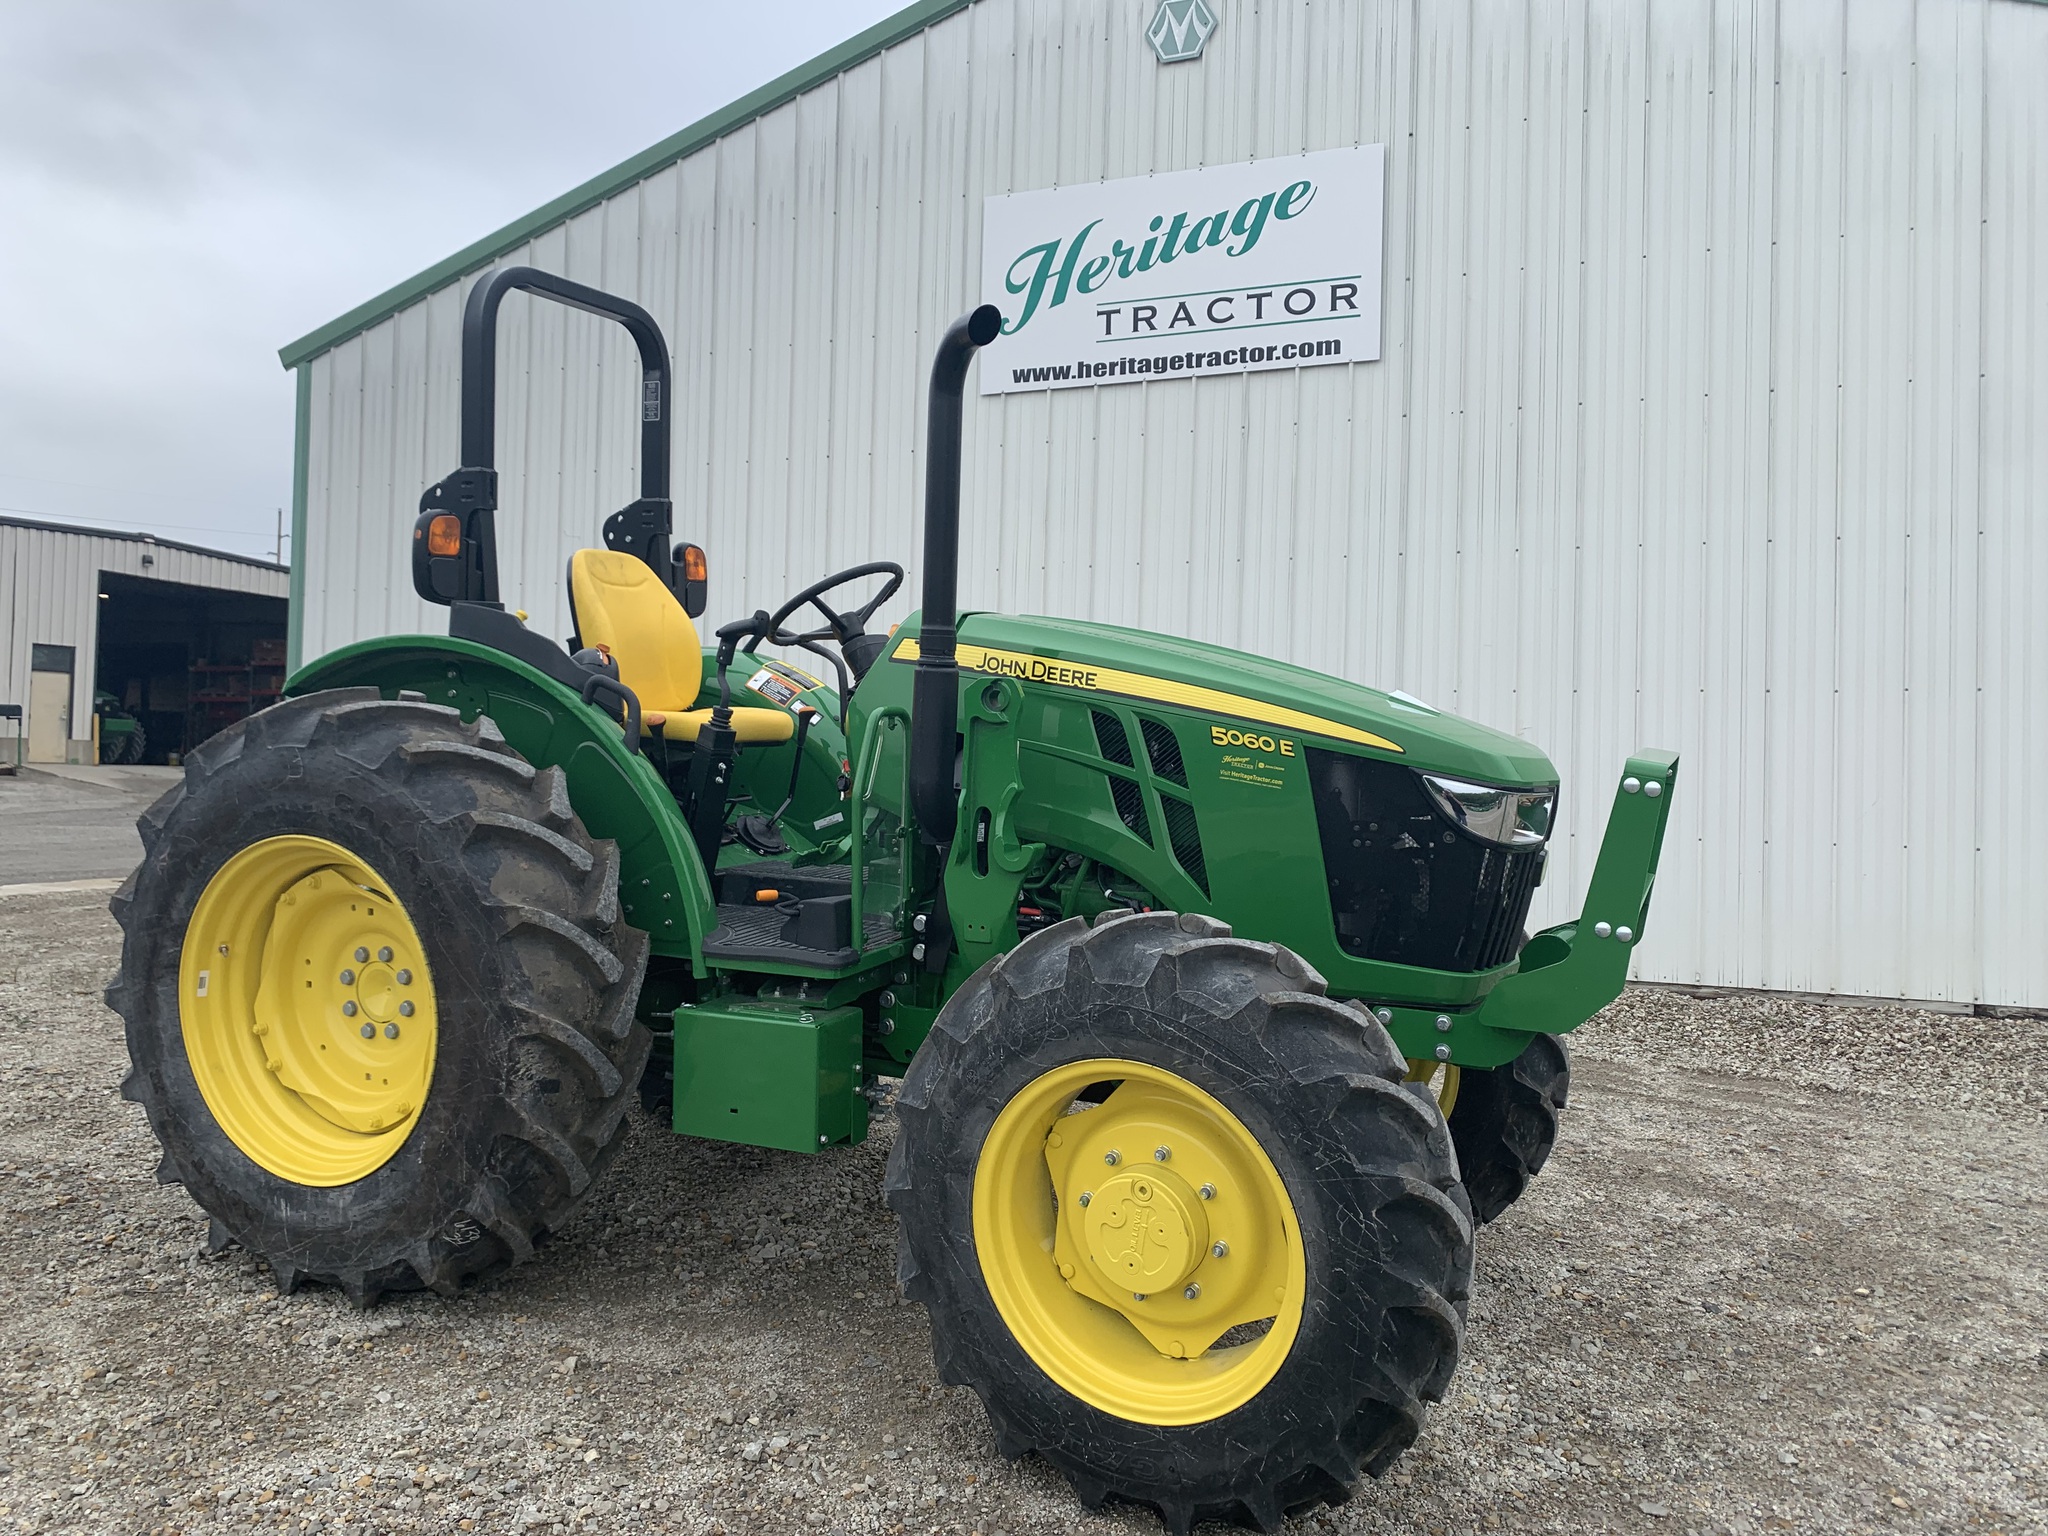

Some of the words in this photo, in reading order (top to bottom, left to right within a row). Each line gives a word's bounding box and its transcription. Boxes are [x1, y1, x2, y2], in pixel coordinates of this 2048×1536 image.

[1000, 180, 1318, 336] Heritage
[1096, 282, 1360, 336] TRACTOR
[1012, 338, 1341, 384] www.heritagetractor.com
[976, 652, 1027, 676] JOHN
[1031, 660, 1098, 688] DEERE
[1211, 725, 1276, 753] 5060
[1279, 738, 1296, 758] E
[1231, 771, 1284, 785] HeritageTractor.com
